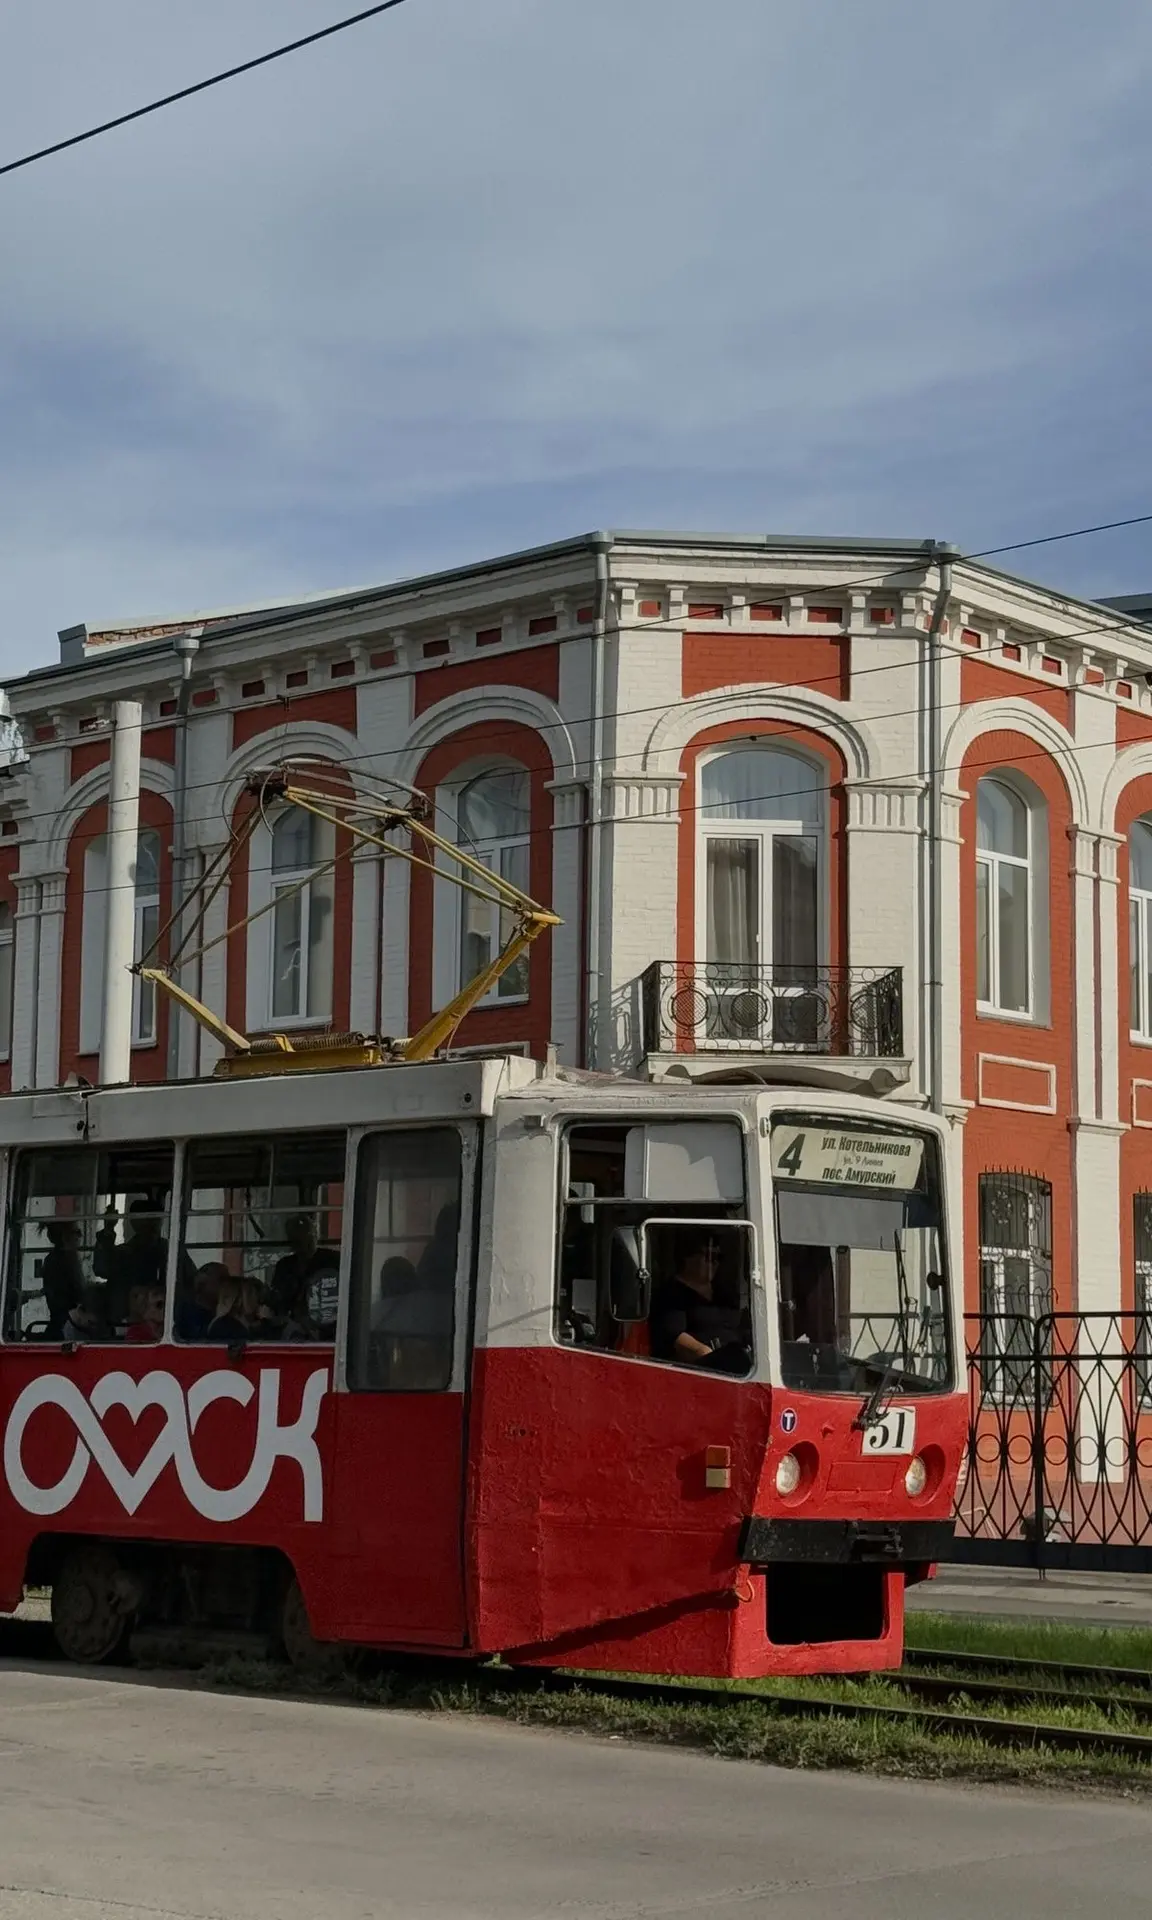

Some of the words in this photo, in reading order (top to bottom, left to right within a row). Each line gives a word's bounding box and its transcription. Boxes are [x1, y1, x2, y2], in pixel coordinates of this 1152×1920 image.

[776, 1133, 806, 1177] 4
[821, 1137, 836, 1151] ул.
[839, 1136, 911, 1157] Котельникова
[822, 1167, 843, 1181] пос.
[844, 1167, 896, 1185] Амурский
[869, 1412, 905, 1449] 51
